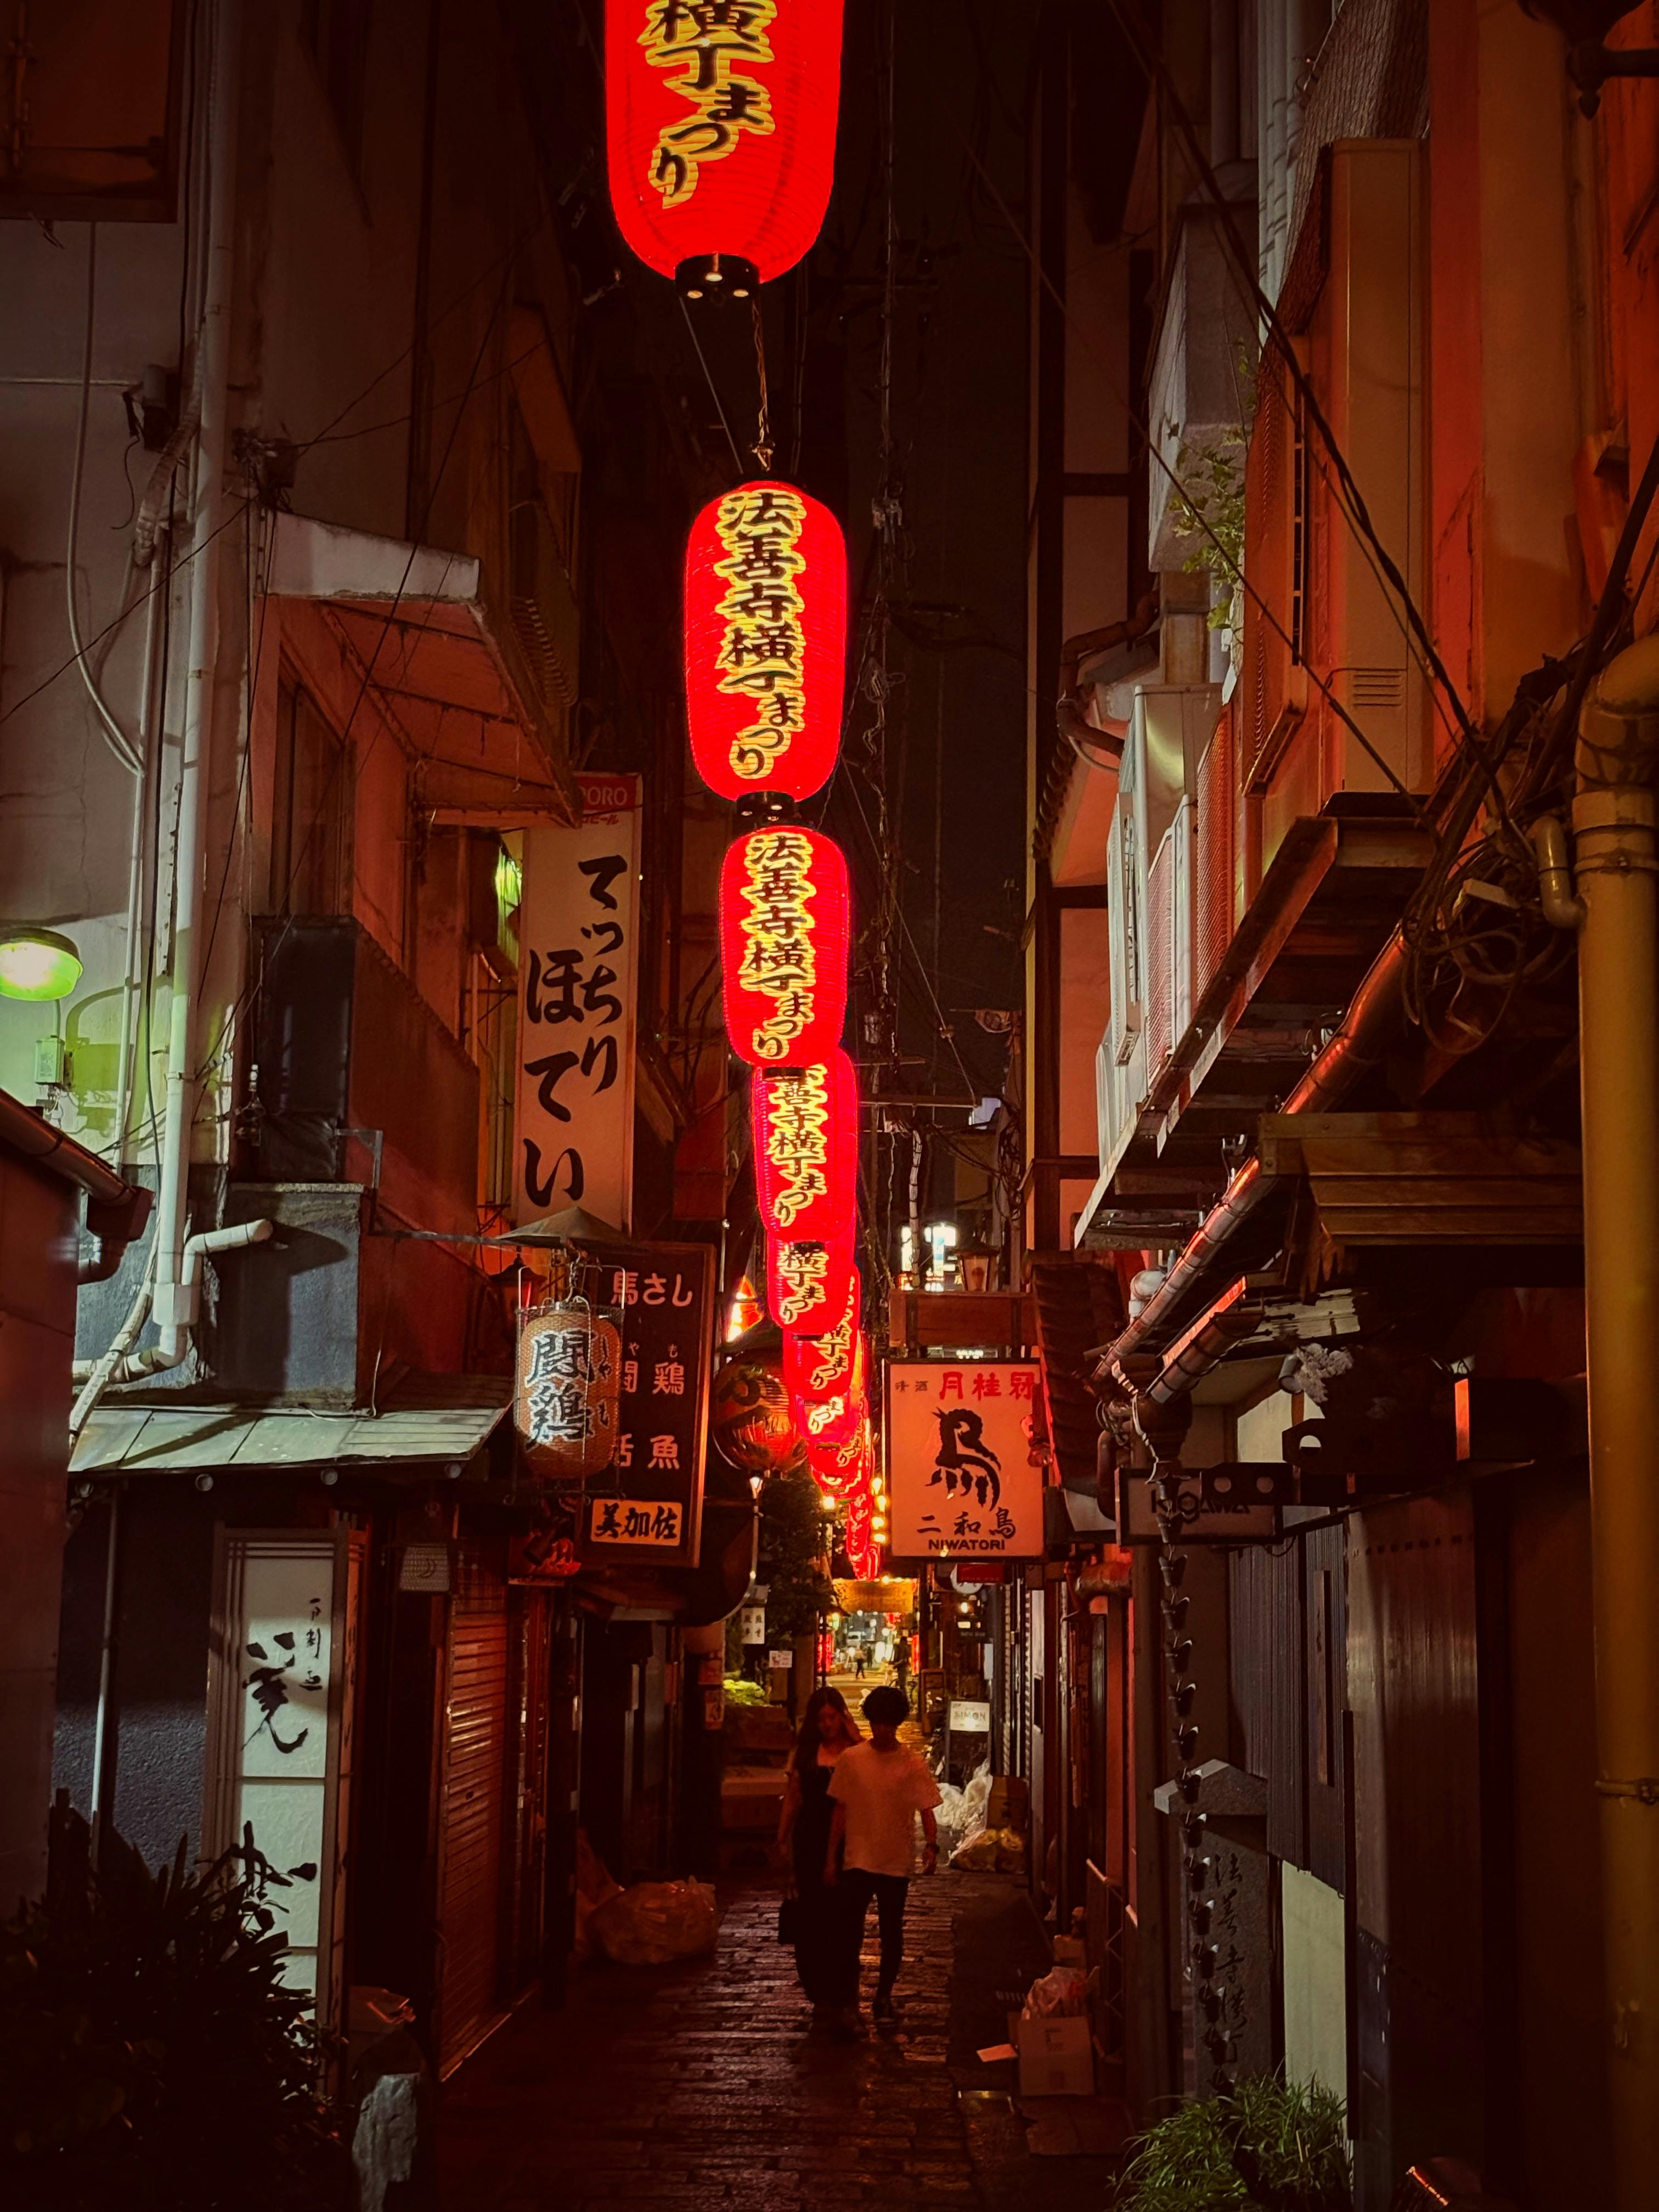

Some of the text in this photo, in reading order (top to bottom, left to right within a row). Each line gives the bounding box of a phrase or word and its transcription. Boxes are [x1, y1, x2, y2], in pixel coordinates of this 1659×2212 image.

[719, 491, 803, 777] 法善寺横丁まつり
[742, 833, 812, 1058] 法善寺横丁まつり
[578, 854, 628, 1096] てっちり
[523, 948, 585, 1207] ほてい
[610, 1272, 693, 1307] 馬さし
[895, 1371, 1035, 1401] 清酒 月桂冠
[595, 1503, 678, 1539] 美加佐
[917, 1507, 1017, 1540] 二和鳥
[928, 1539, 1005, 1550] NIWATORI
